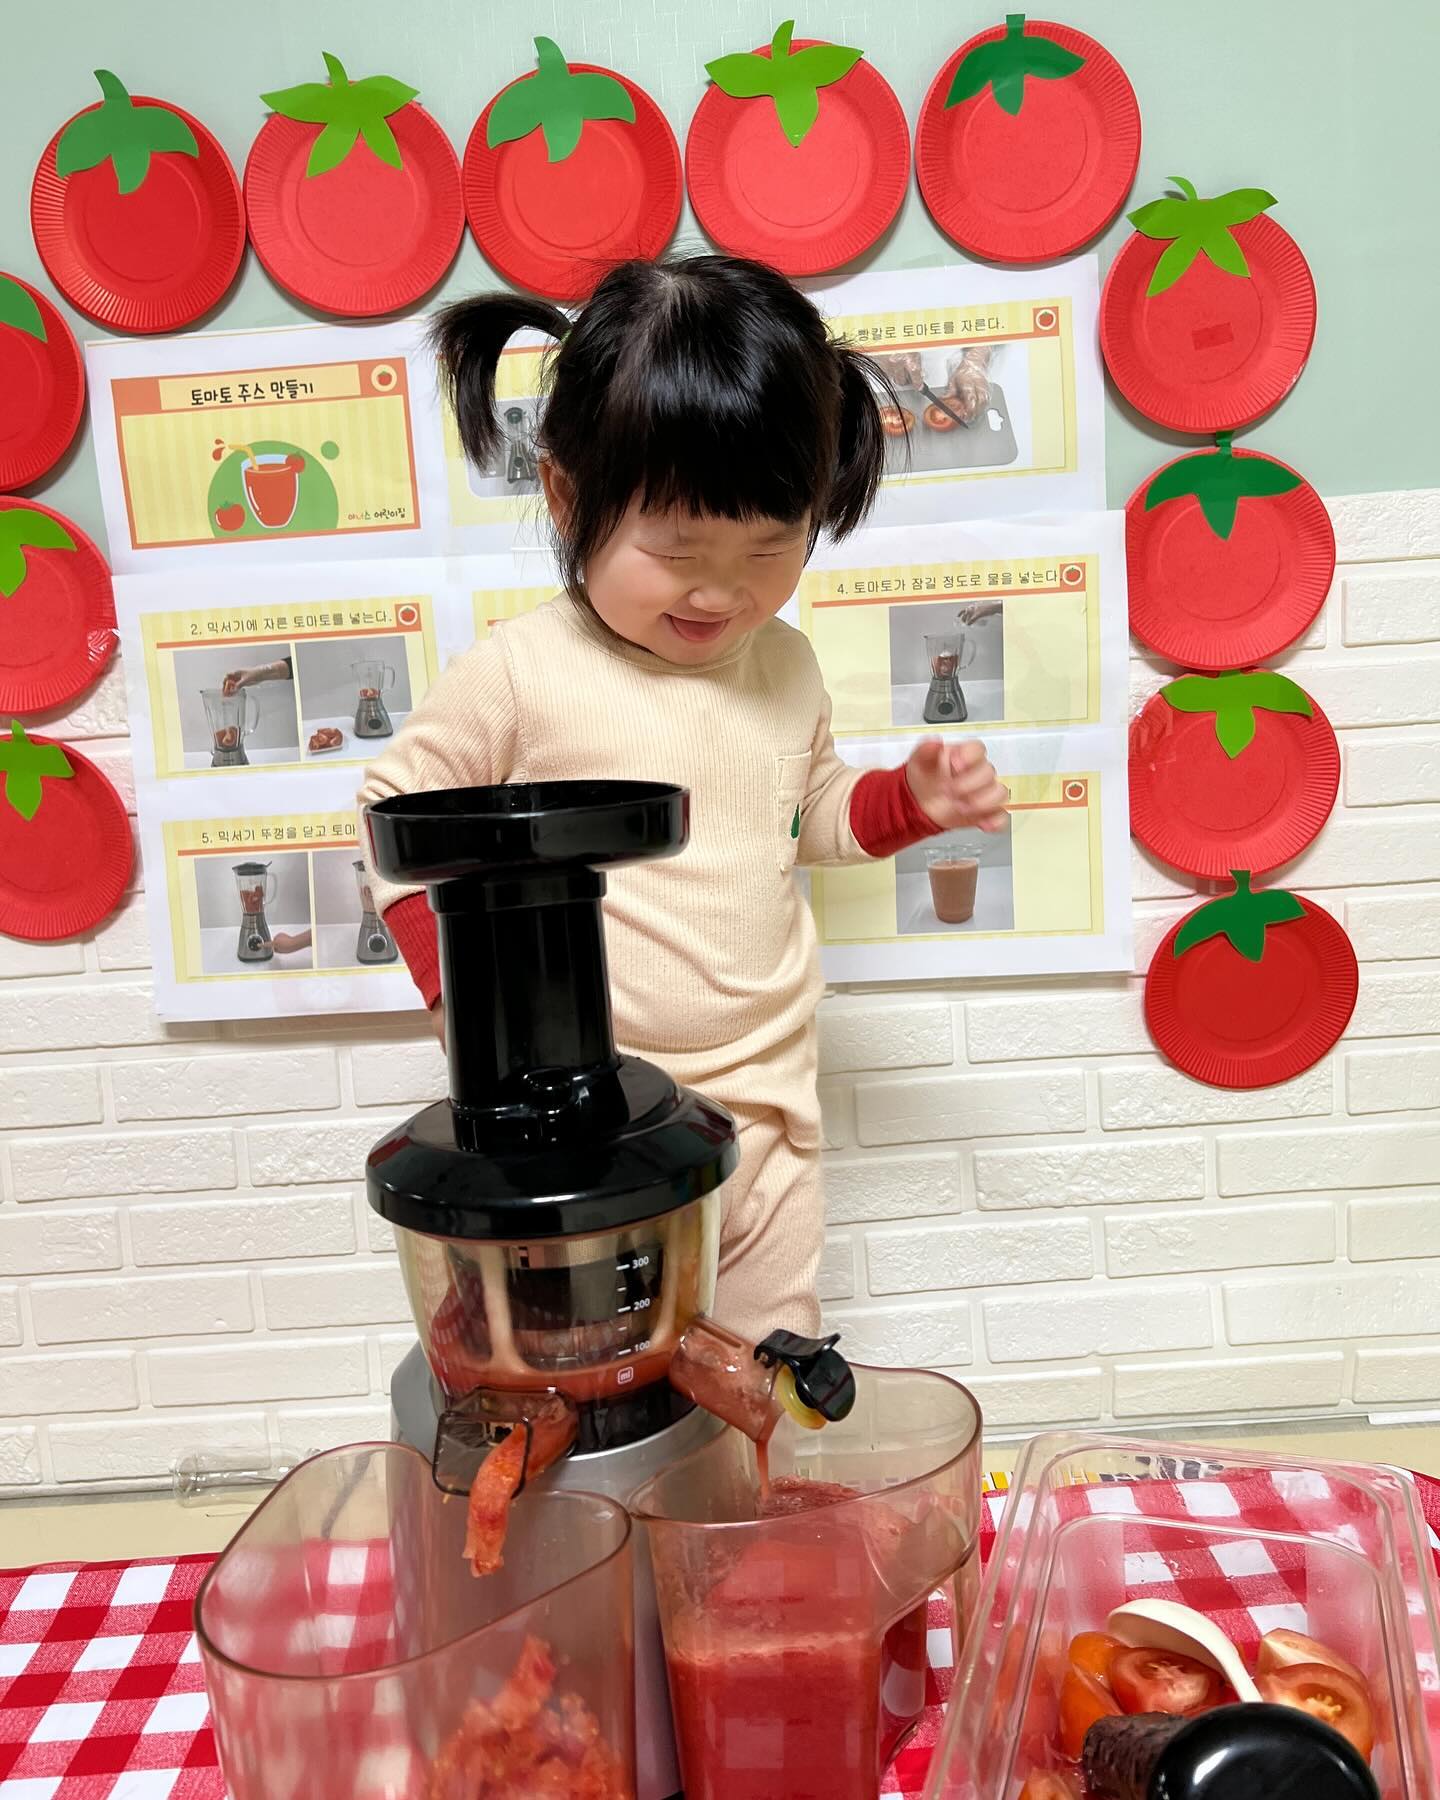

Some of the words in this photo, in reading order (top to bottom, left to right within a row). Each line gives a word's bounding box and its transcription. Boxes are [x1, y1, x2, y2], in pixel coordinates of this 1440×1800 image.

[857, 326, 897, 342] 빵칼로
[903, 322, 955, 337] 토마토를
[961, 317, 1005, 332] 자른다.
[191, 387, 233, 406] 토마토
[238, 383, 266, 403] 주스
[270, 379, 314, 399] 만들기
[374, 507, 406, 519] 어린이집
[837, 583, 849, 595] 4.
[854, 579, 906, 594] 토마토가
[911, 576, 937, 591] 잠길
[943, 574, 982, 589] 정도로
[987, 572, 1013, 586] 물을
[190, 623, 203, 636] 2.
[207, 618, 258, 635] 믹서기에
[263, 615, 289, 631] 자른
[293, 612, 344, 628] 토마토를
[349, 610, 392, 625] 넣는다.
[201, 832, 213, 844] 5.
[218, 829, 255, 843] 믹서기
[261, 827, 297, 840] 뚜껑을
[303, 824, 327, 838] 닫고
[632, 1255, 650, 1270] 300
[633, 1297, 651, 1312] 200
[634, 1340, 651, 1353] 100
